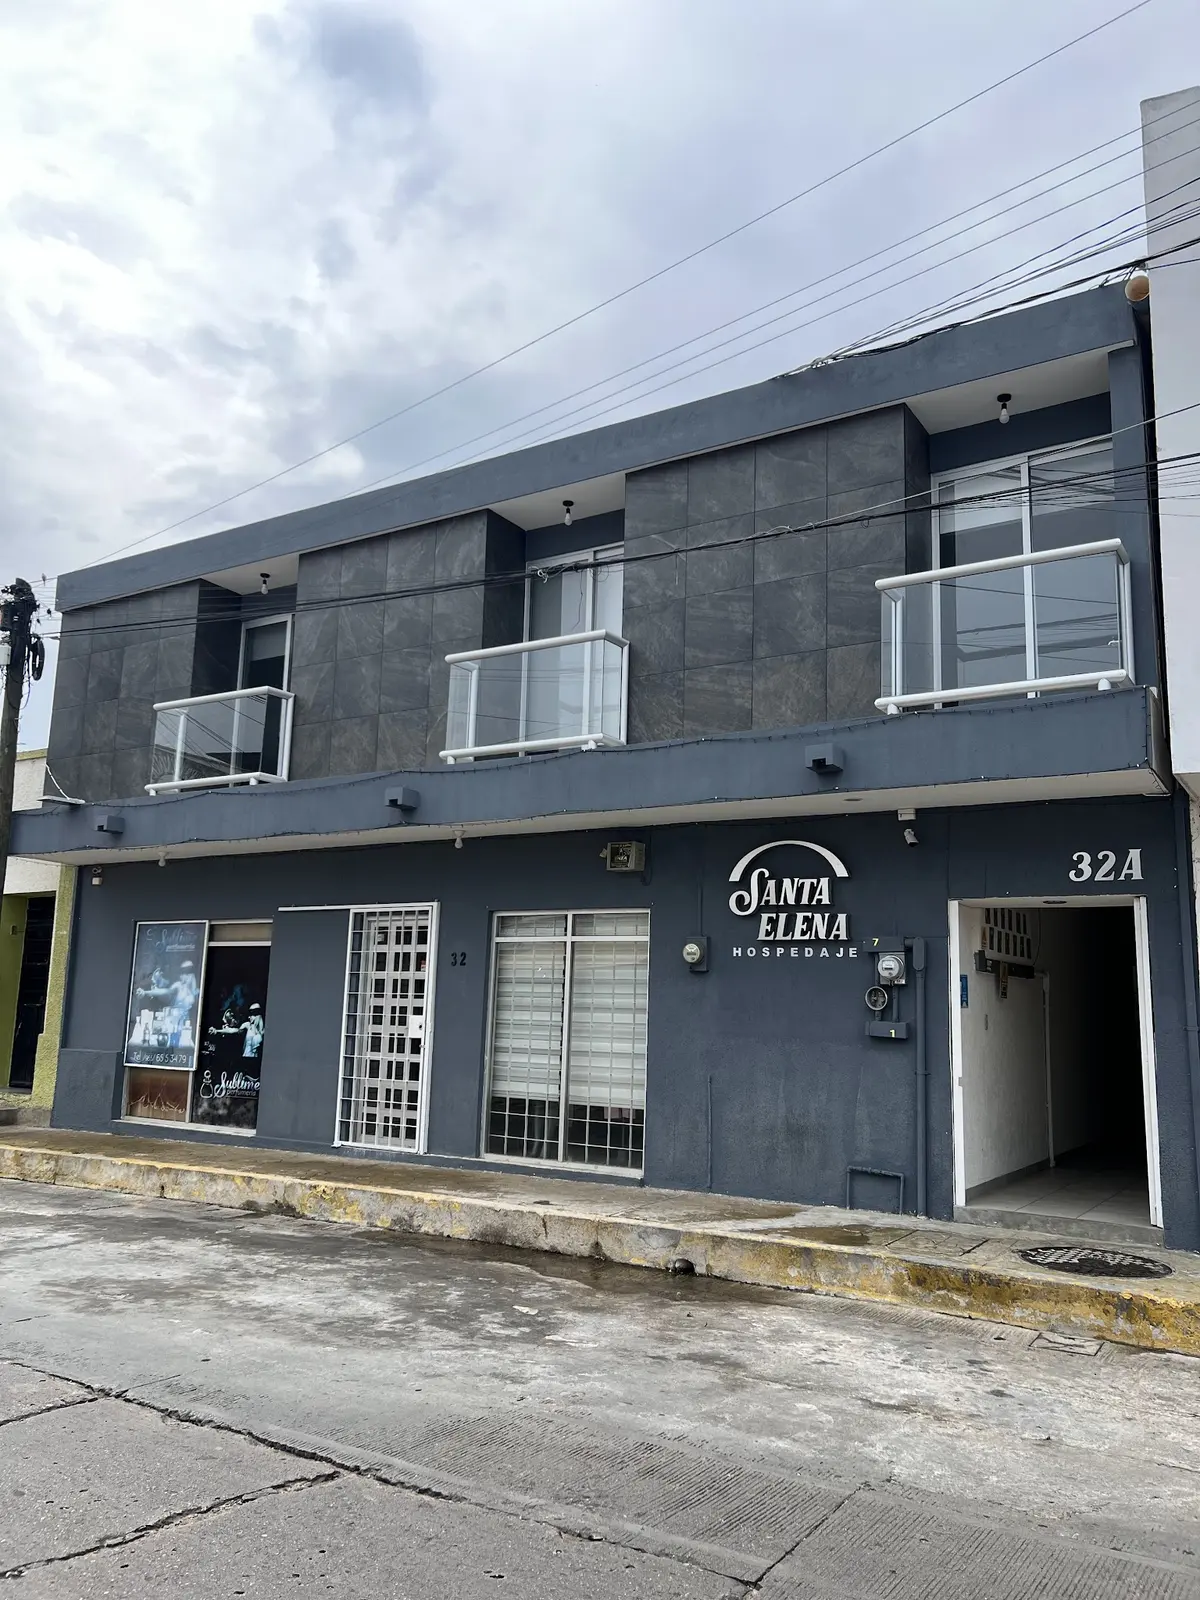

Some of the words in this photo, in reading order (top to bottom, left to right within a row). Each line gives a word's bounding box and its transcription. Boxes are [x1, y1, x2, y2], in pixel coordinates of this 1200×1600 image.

[1068, 848, 1144, 882] 32A
[728, 868, 831, 916] SANTA
[757, 911, 848, 941] ELENA
[732, 947, 858, 957] HOSPEDAJE
[871, 937, 879, 946] 7
[450, 952, 467, 967] 32
[889, 1029, 895, 1038] 1
[213, 1071, 261, 1098] Sublime
